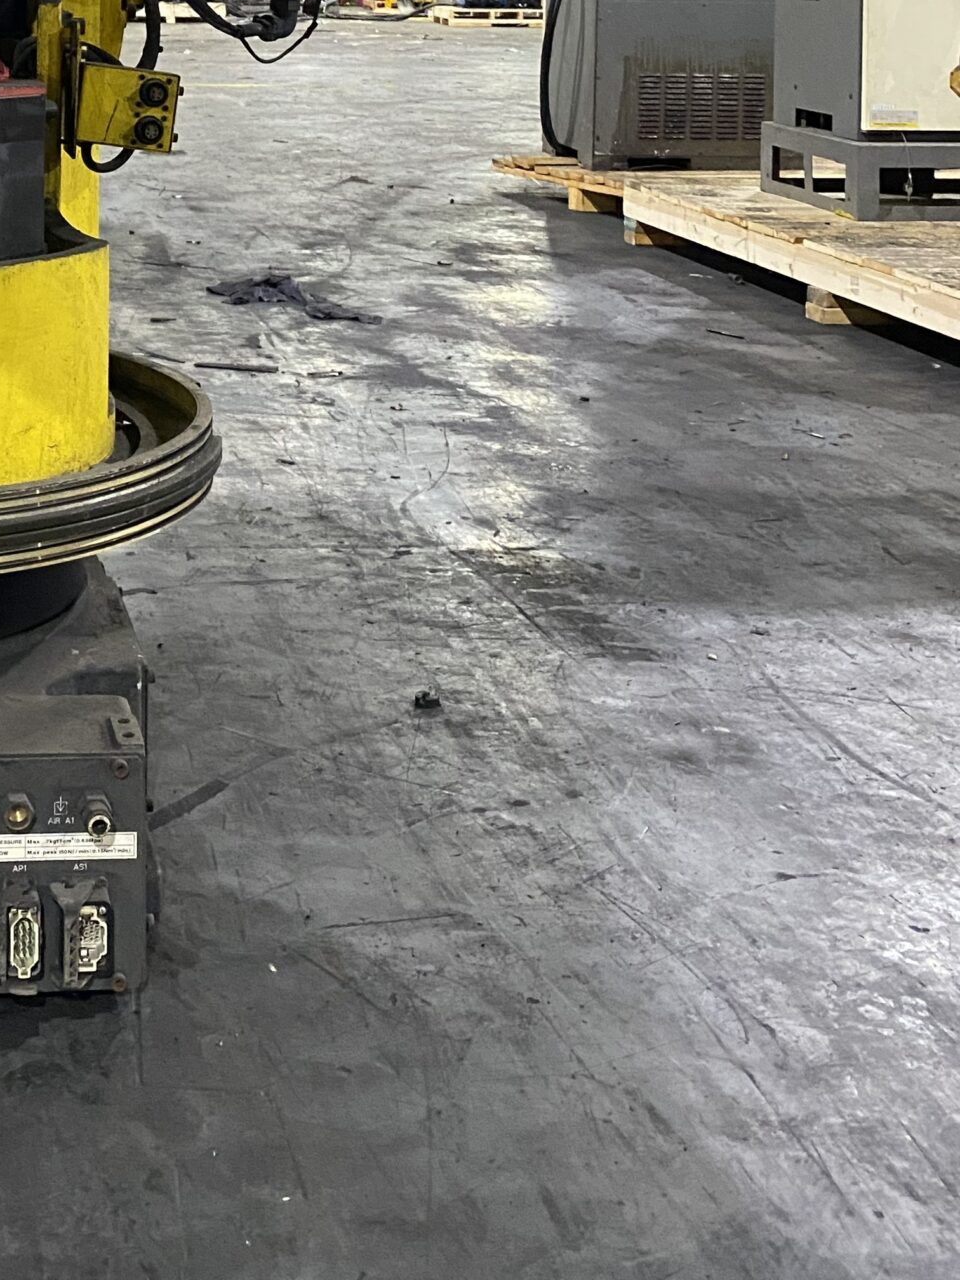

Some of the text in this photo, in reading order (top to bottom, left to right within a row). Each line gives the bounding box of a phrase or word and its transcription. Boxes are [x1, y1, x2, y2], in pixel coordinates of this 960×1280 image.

[48, 817, 63, 825] AIR
[13, 865, 27, 873] AP1
[73, 863, 88, 871] AS1
